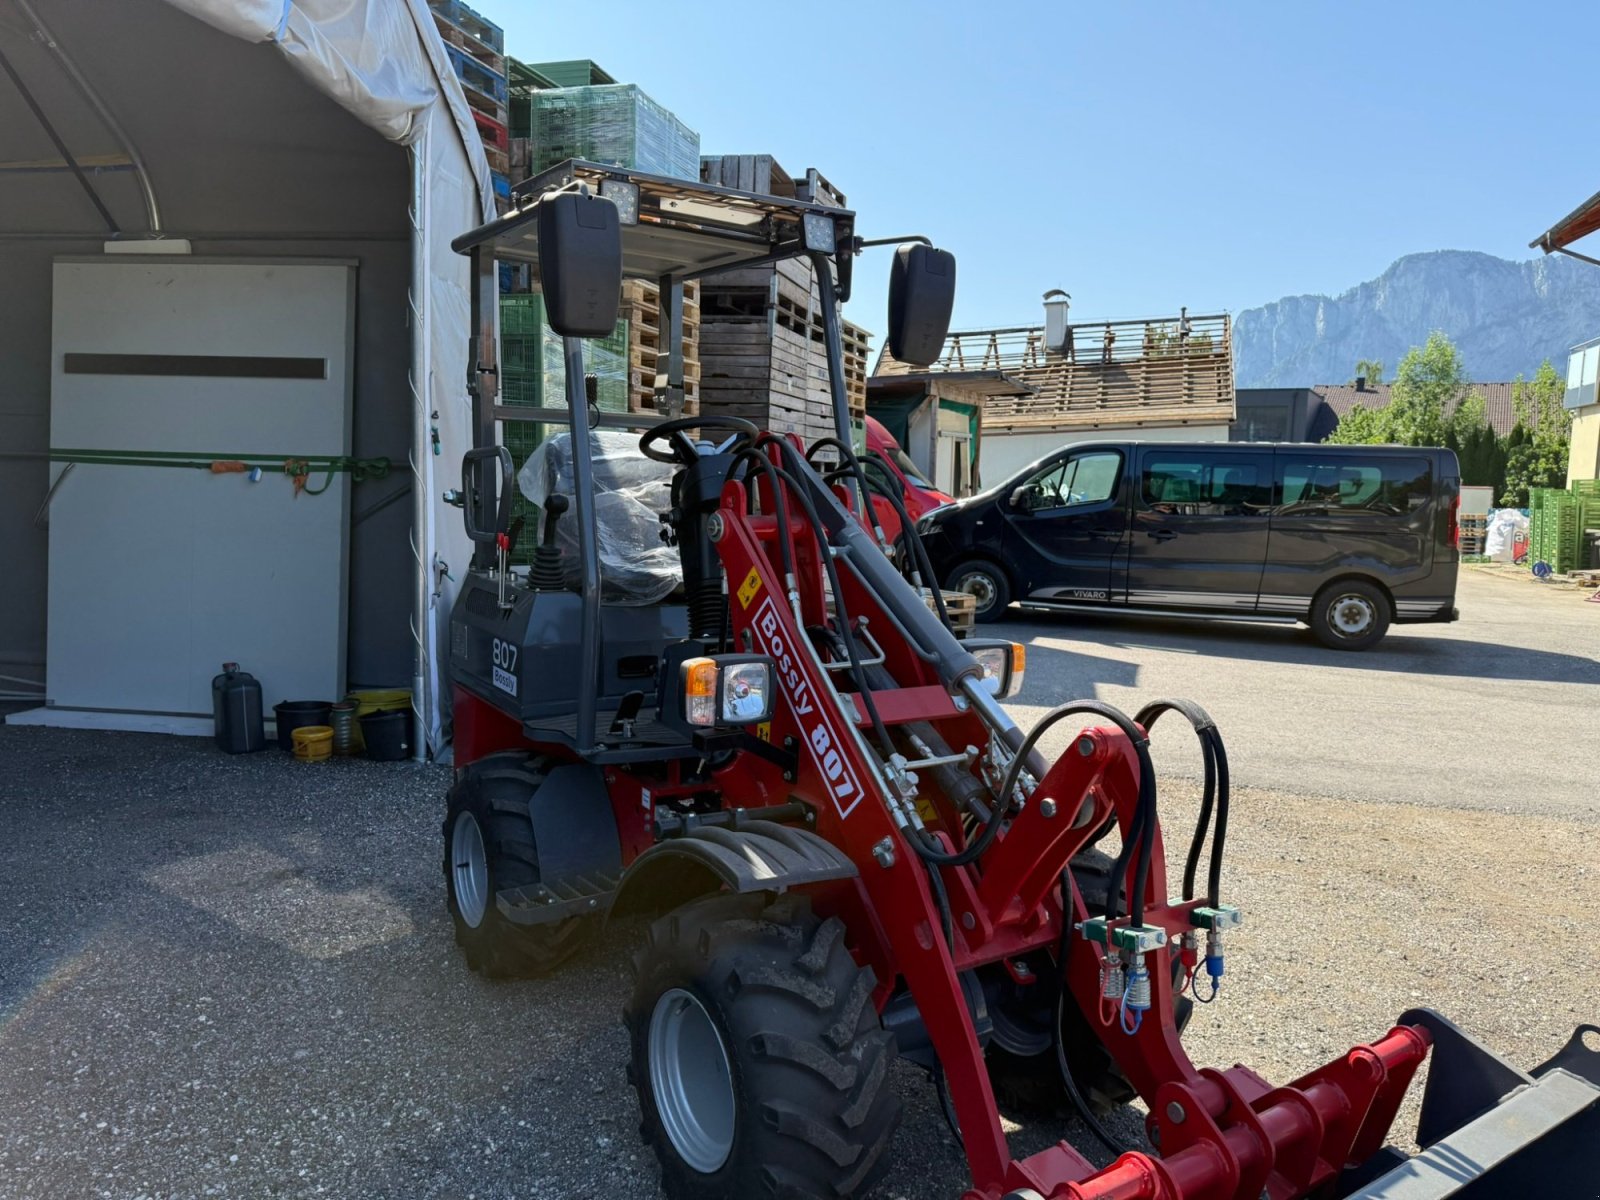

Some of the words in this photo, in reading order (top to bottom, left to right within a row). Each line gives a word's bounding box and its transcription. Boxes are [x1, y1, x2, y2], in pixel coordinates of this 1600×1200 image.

[1074, 590, 1106, 599] VIVARO
[492, 638, 518, 671] 807
[494, 671, 515, 691] Bossly
[761, 611, 813, 715] Bossly
[811, 724, 854, 797] 807
